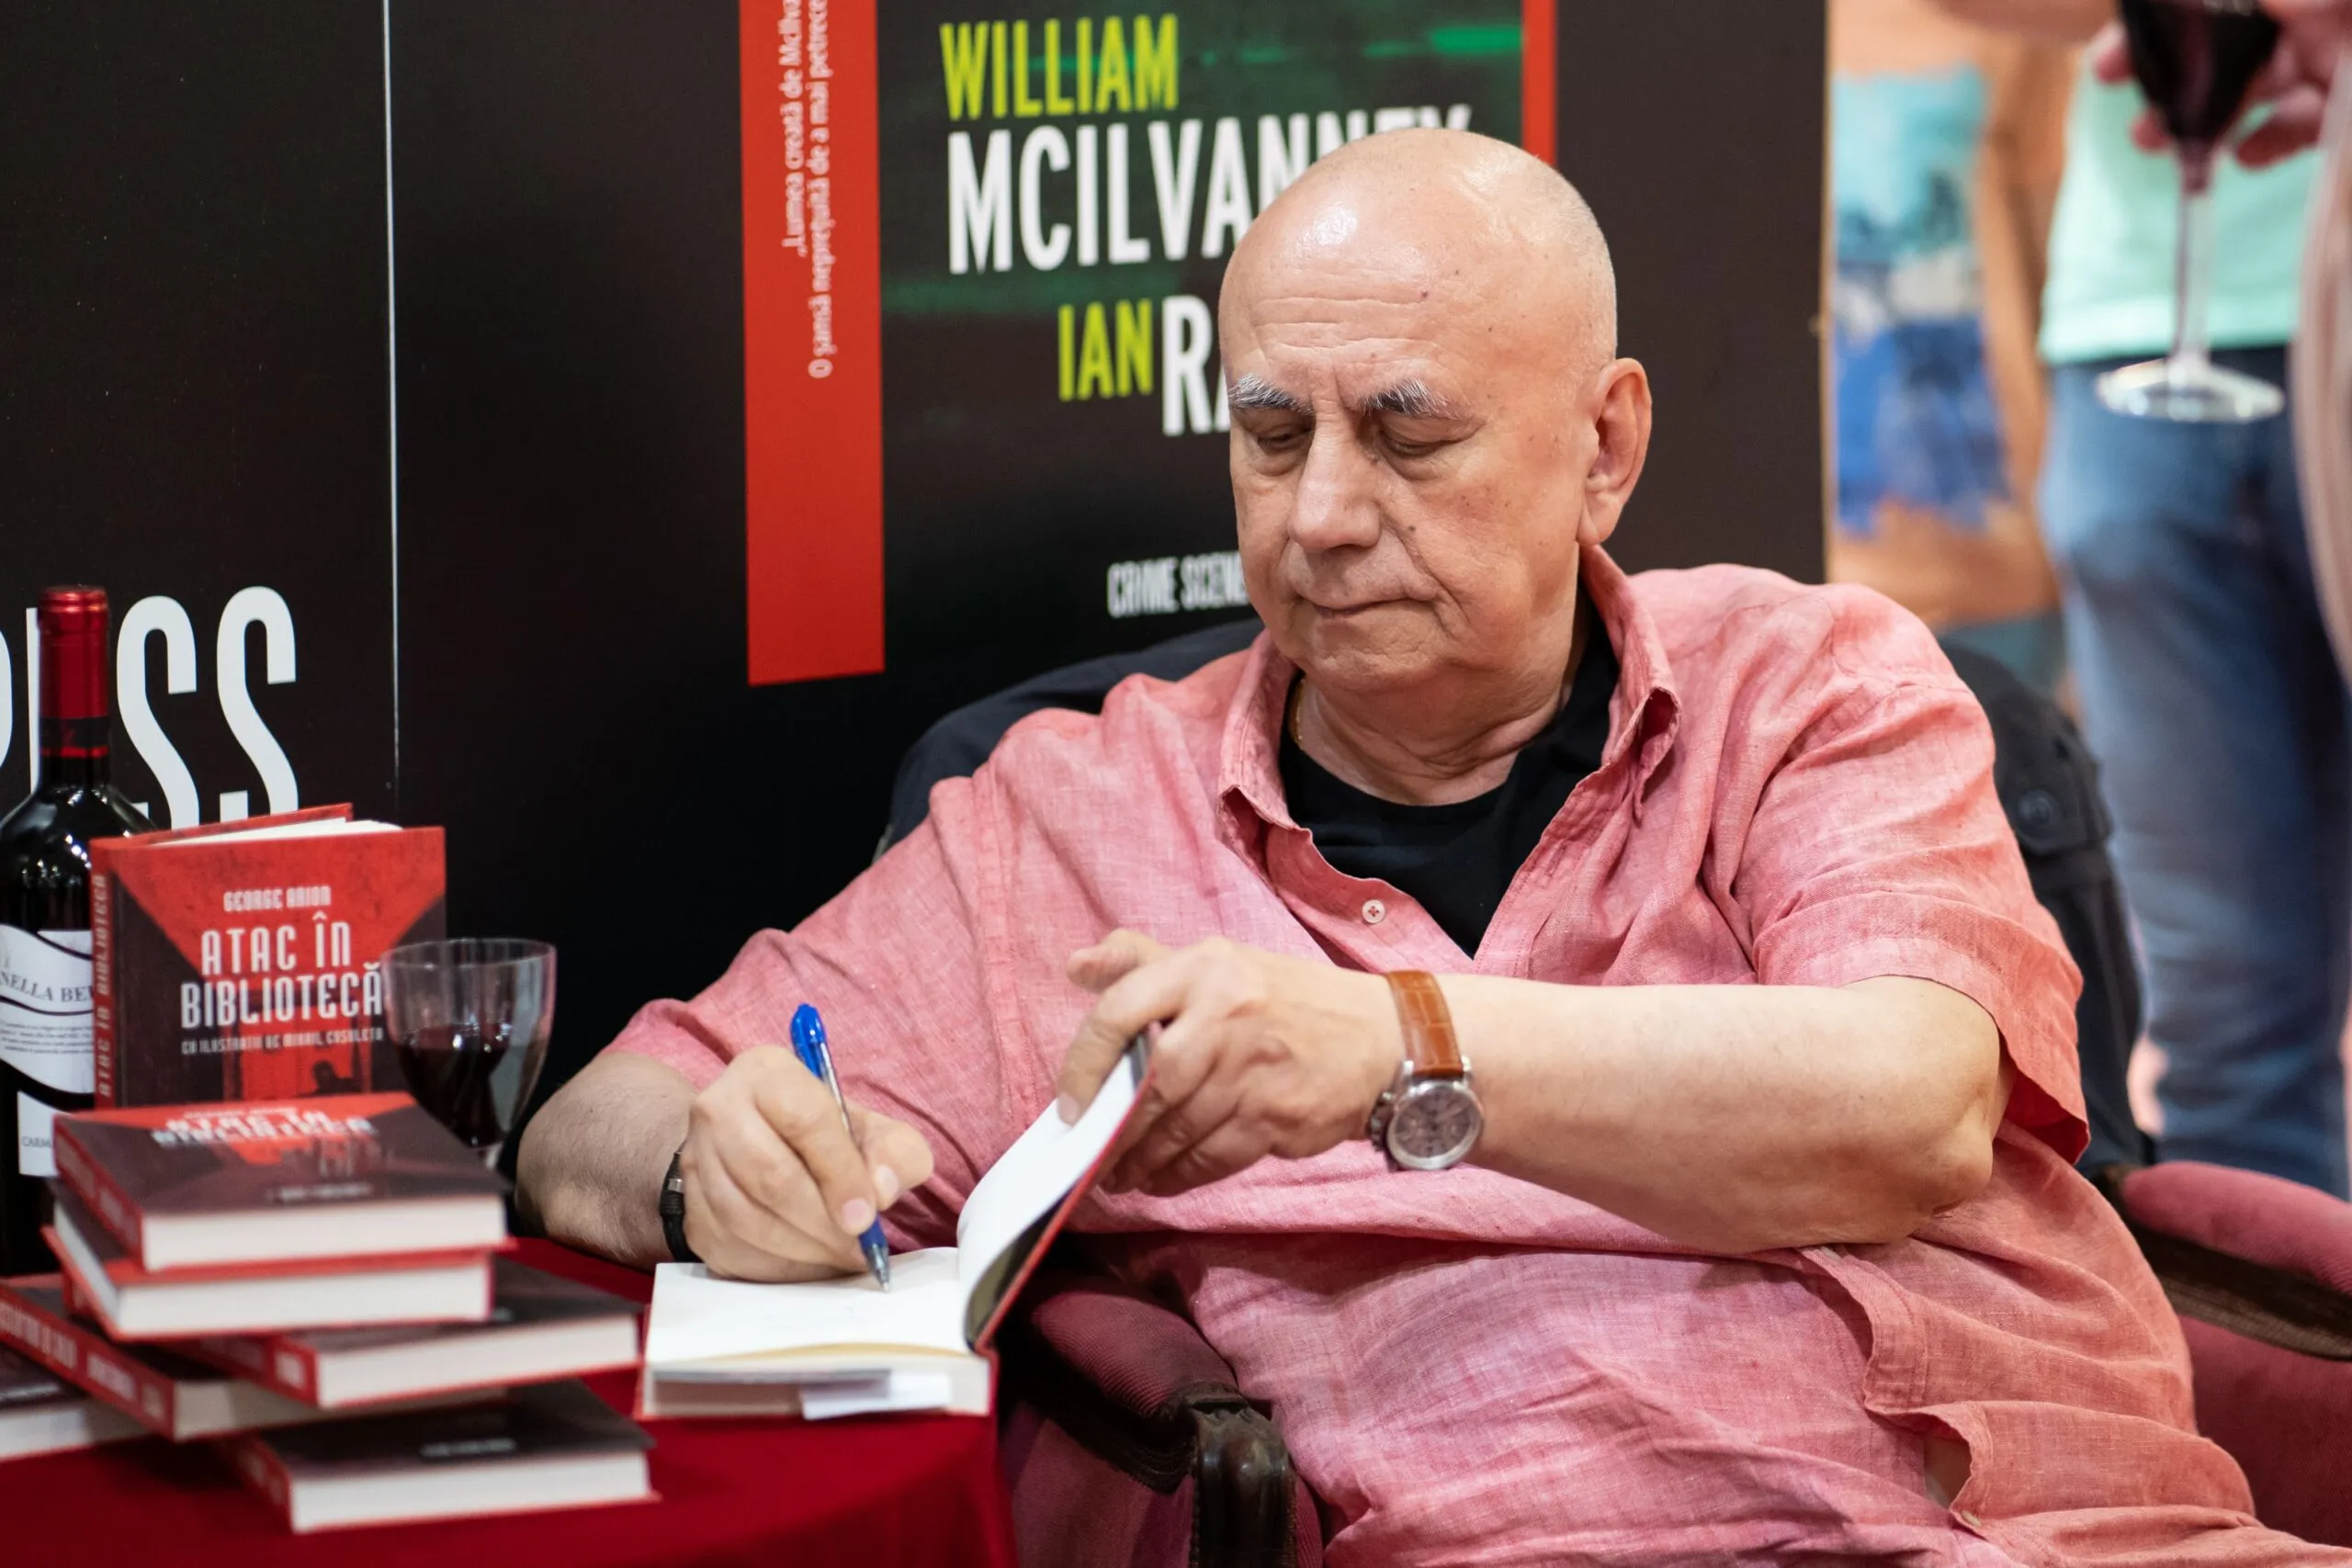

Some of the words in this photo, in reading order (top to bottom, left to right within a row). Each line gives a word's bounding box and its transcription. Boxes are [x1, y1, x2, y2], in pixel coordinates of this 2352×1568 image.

[778, 68, 804, 99] de
[940, 14, 1178, 120] WILLIAM
[809, 127, 831, 143] a
[805, 145, 831, 175] de
[808, 359, 834, 378] O
[1058, 298, 1153, 401] IAN
[1161, 295, 1231, 436] R
[1107, 556, 1180, 618] CRIME
[223, 888, 283, 912] GEORGE
[201, 924, 297, 976] ATAC
[180, 962, 383, 1029] BIBLIOTECĂ
